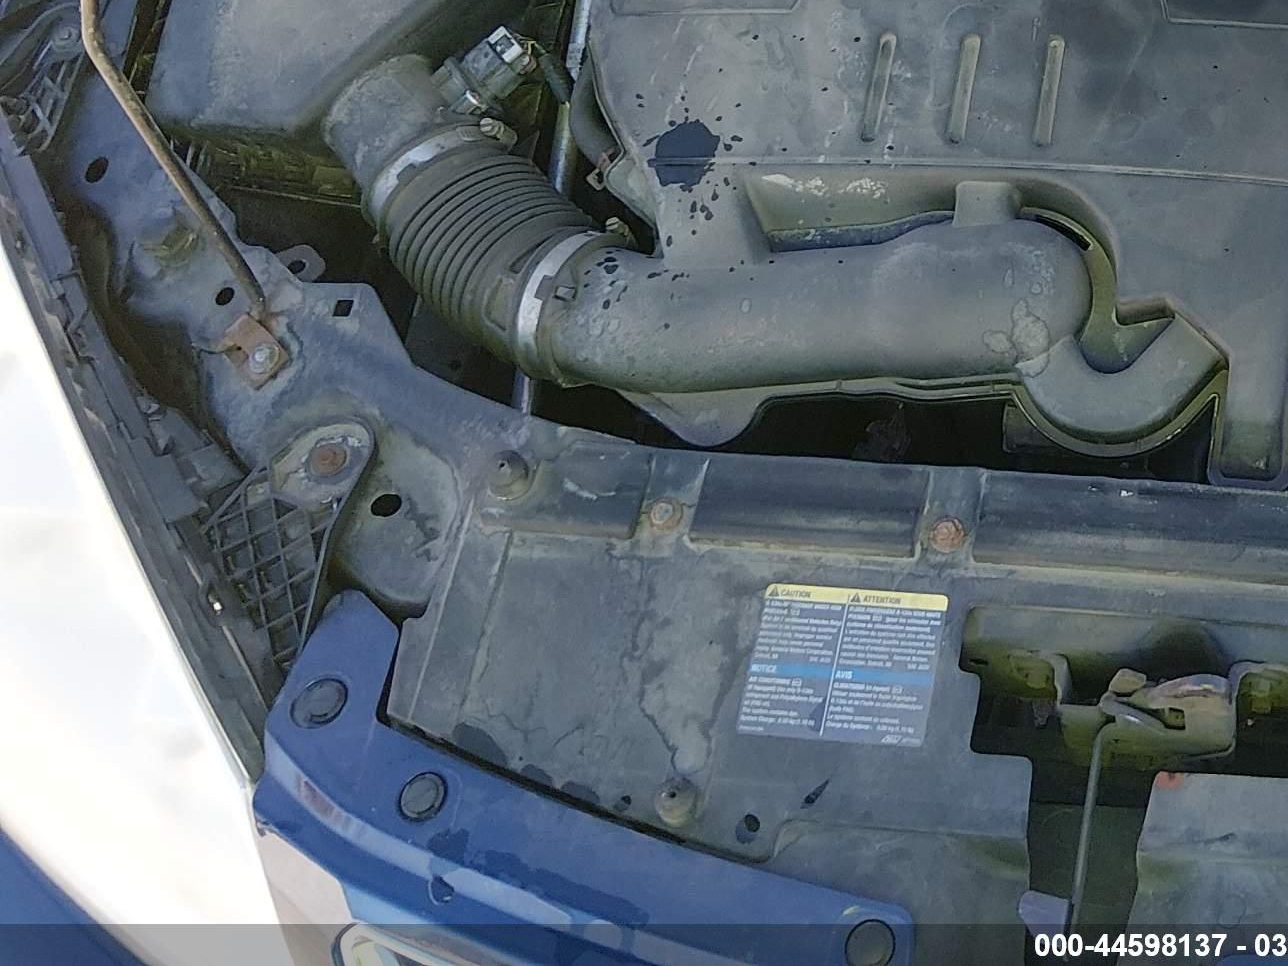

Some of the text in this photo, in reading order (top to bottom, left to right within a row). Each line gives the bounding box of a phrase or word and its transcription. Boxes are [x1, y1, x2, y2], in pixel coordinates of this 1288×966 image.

[780, 588, 811, 599] CAUTION
[862, 595, 901, 604] ATTENTION
[835, 670, 853, 680] AVIS
